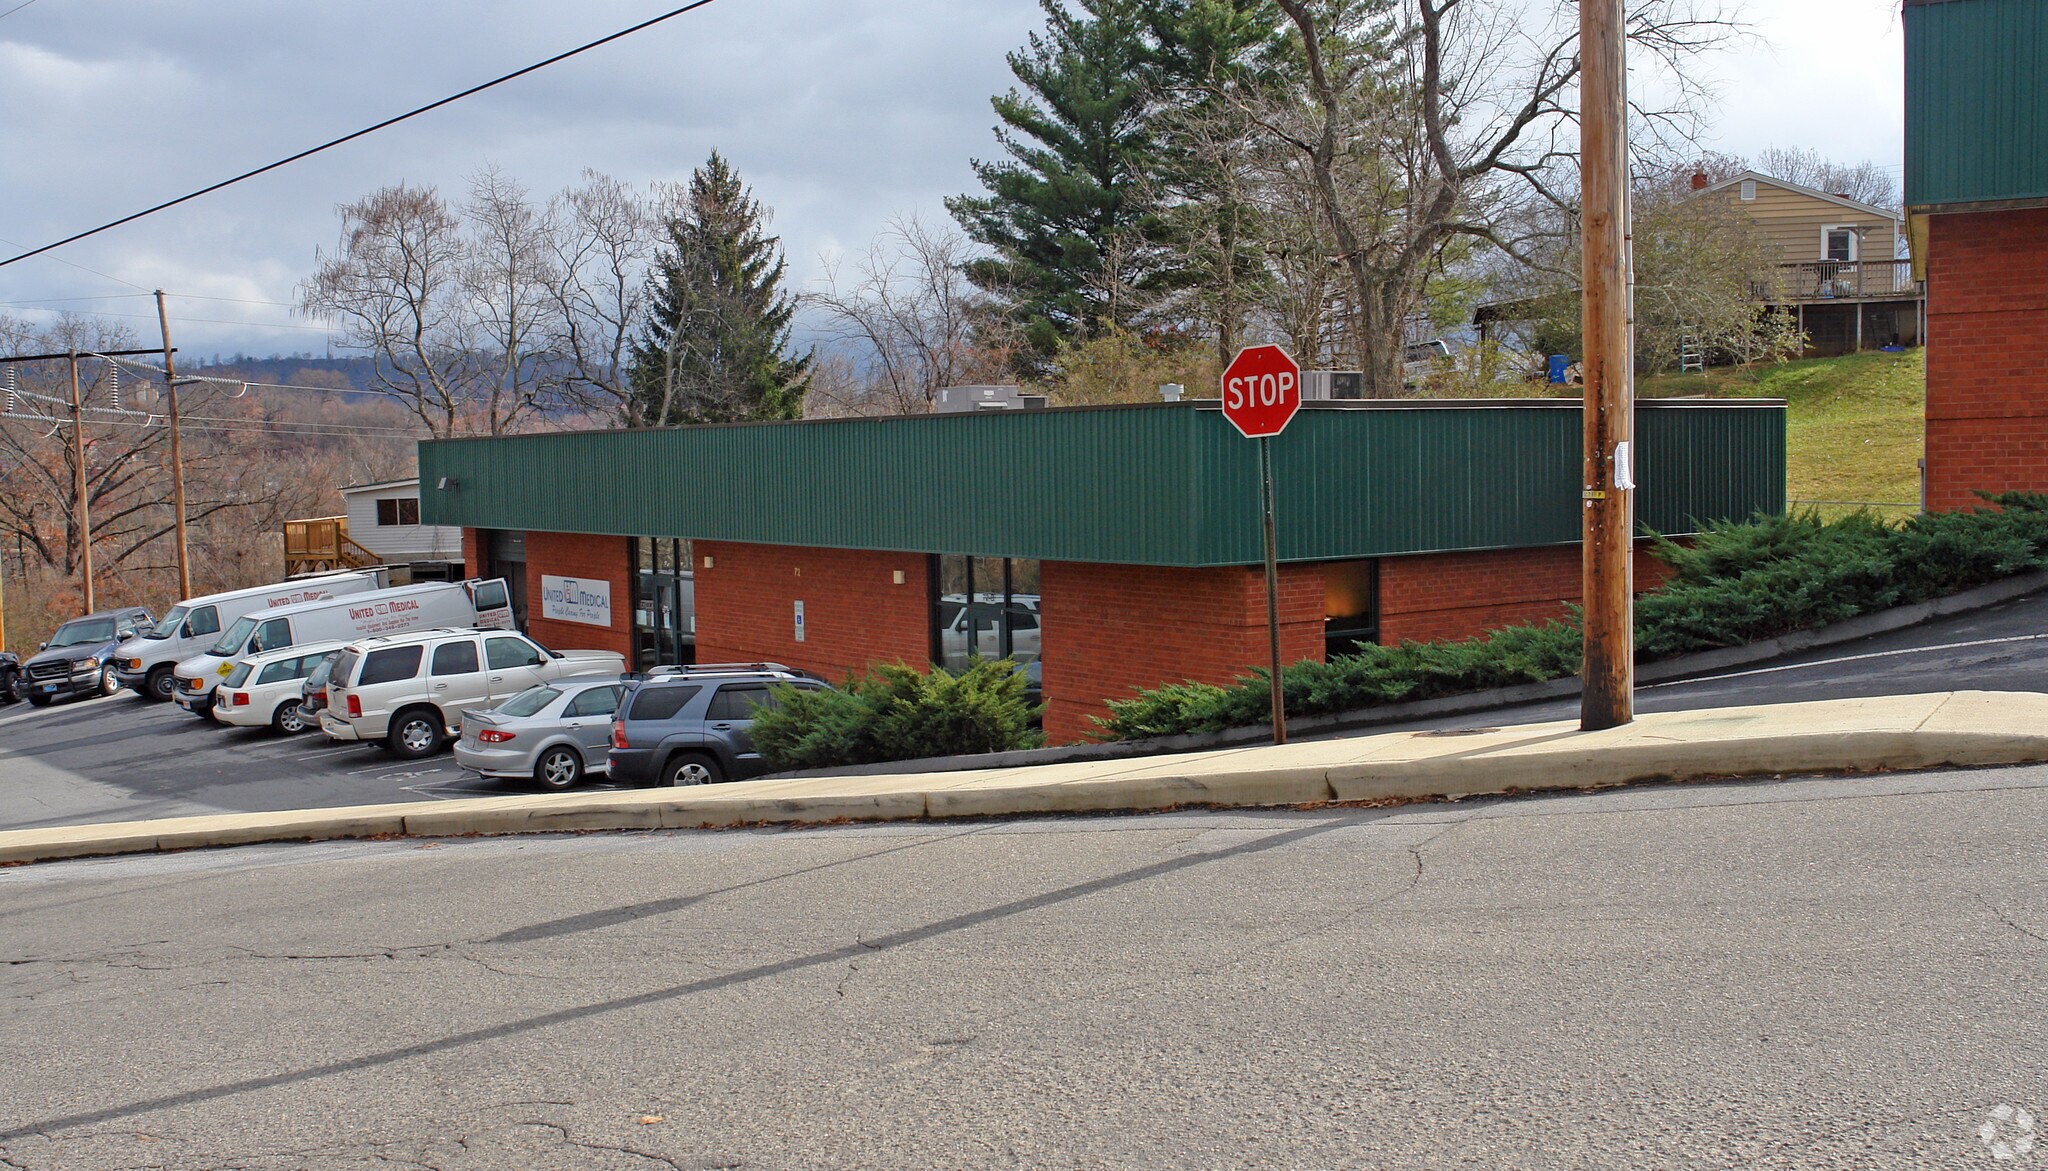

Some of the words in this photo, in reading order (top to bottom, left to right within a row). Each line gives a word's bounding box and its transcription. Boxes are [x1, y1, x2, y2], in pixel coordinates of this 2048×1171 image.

[1228, 371, 1294, 410] STOP
[267, 598, 291, 608] UNITED
[543, 586, 564, 603] UNITED
[580, 591, 609, 609] MEDICAL
[349, 607, 374, 620] UNITED
[389, 600, 419, 614] MEDICAL
